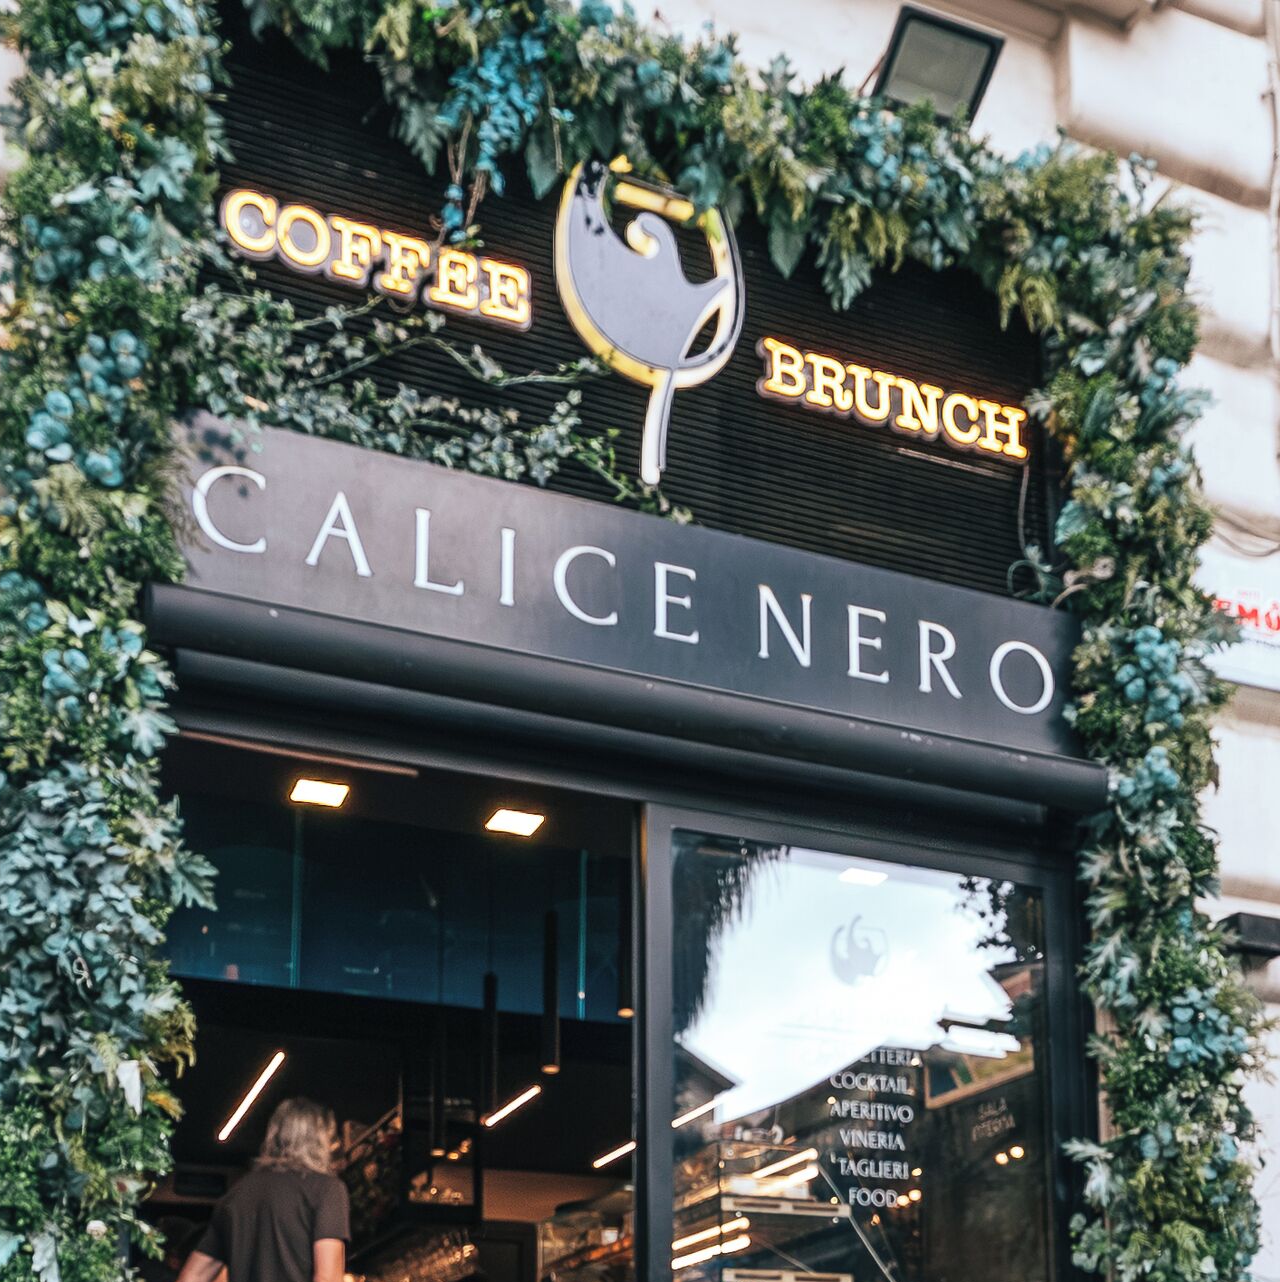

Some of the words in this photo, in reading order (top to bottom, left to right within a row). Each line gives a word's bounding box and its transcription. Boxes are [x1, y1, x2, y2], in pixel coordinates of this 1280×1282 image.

[224, 189, 531, 327] COFFEE
[762, 337, 1030, 460] BRUNCH
[191, 465, 700, 644] CALICE
[757, 583, 1054, 715] NERO
[829, 1071, 913, 1096] COCKTAIL
[830, 1101, 914, 1124] APERITIVO
[839, 1129, 906, 1152] VINERIA
[838, 1157, 910, 1180] TAGLIERI
[848, 1187, 897, 1208] FOOD
